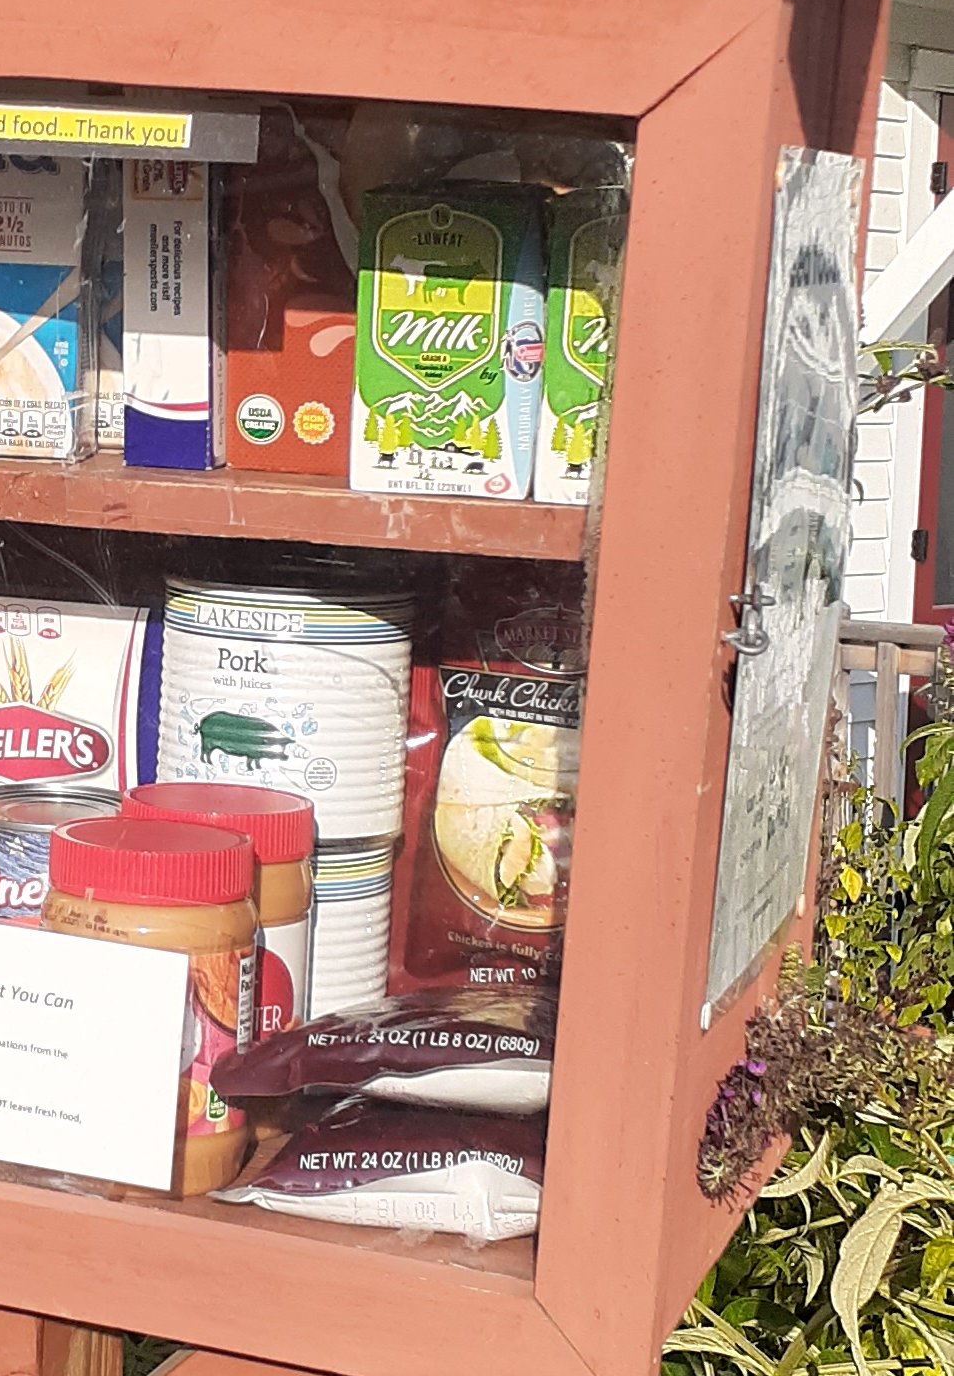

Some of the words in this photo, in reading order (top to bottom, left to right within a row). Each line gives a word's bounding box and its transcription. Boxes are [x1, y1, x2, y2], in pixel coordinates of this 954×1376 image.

[141, 117, 186, 147] you!
[17, 202, 32, 215] EN
[387, 311, 484, 352] Milk
[479, 367, 498, 386] by
[517, 385, 533, 452] NATURALLY
[195, 605, 304, 633] LAKESIDE
[217, 646, 269, 674] Pork
[213, 675, 237, 687] with
[443, 673, 510, 704] Chunk
[510, 682, 580, 713] Chicke
[447, 931, 493, 950] Chicken
[496, 940, 508, 951] is
[511, 943, 543, 961] fully
[470, 967, 493, 983] NET
[495, 967, 516, 983] WT
[521, 966, 537, 981] 10
[12, 985, 40, 1004] You
[44, 992, 74, 1011] Can
[254, 1005, 282, 1033] TER
[30, 1042, 52, 1057] from
[54, 1049, 69, 1061] the
[307, 1033, 338, 1047] NET
[367, 1030, 385, 1044] 24
[388, 1030, 411, 1045] OZ
[413, 1031, 426, 1049] (1
[430, 1032, 450, 1048] LB
[453, 1033, 462, 1048] 8
[465, 1035, 492, 1054] OZ)
[494, 1035, 540, 1057] (680g)
[10, 1100, 33, 1115] leave
[35, 1105, 57, 1120] fresh
[59, 1110, 83, 1126] food,
[299, 1152, 330, 1170] NET
[332, 1152, 357, 1170] WT.
[361, 1153, 379, 1170] 24
[381, 1152, 404, 1170] OZ
[406, 1152, 419, 1173] (1
[422, 1152, 442, 1169] LB
[446, 1151, 454, 1169] 8
